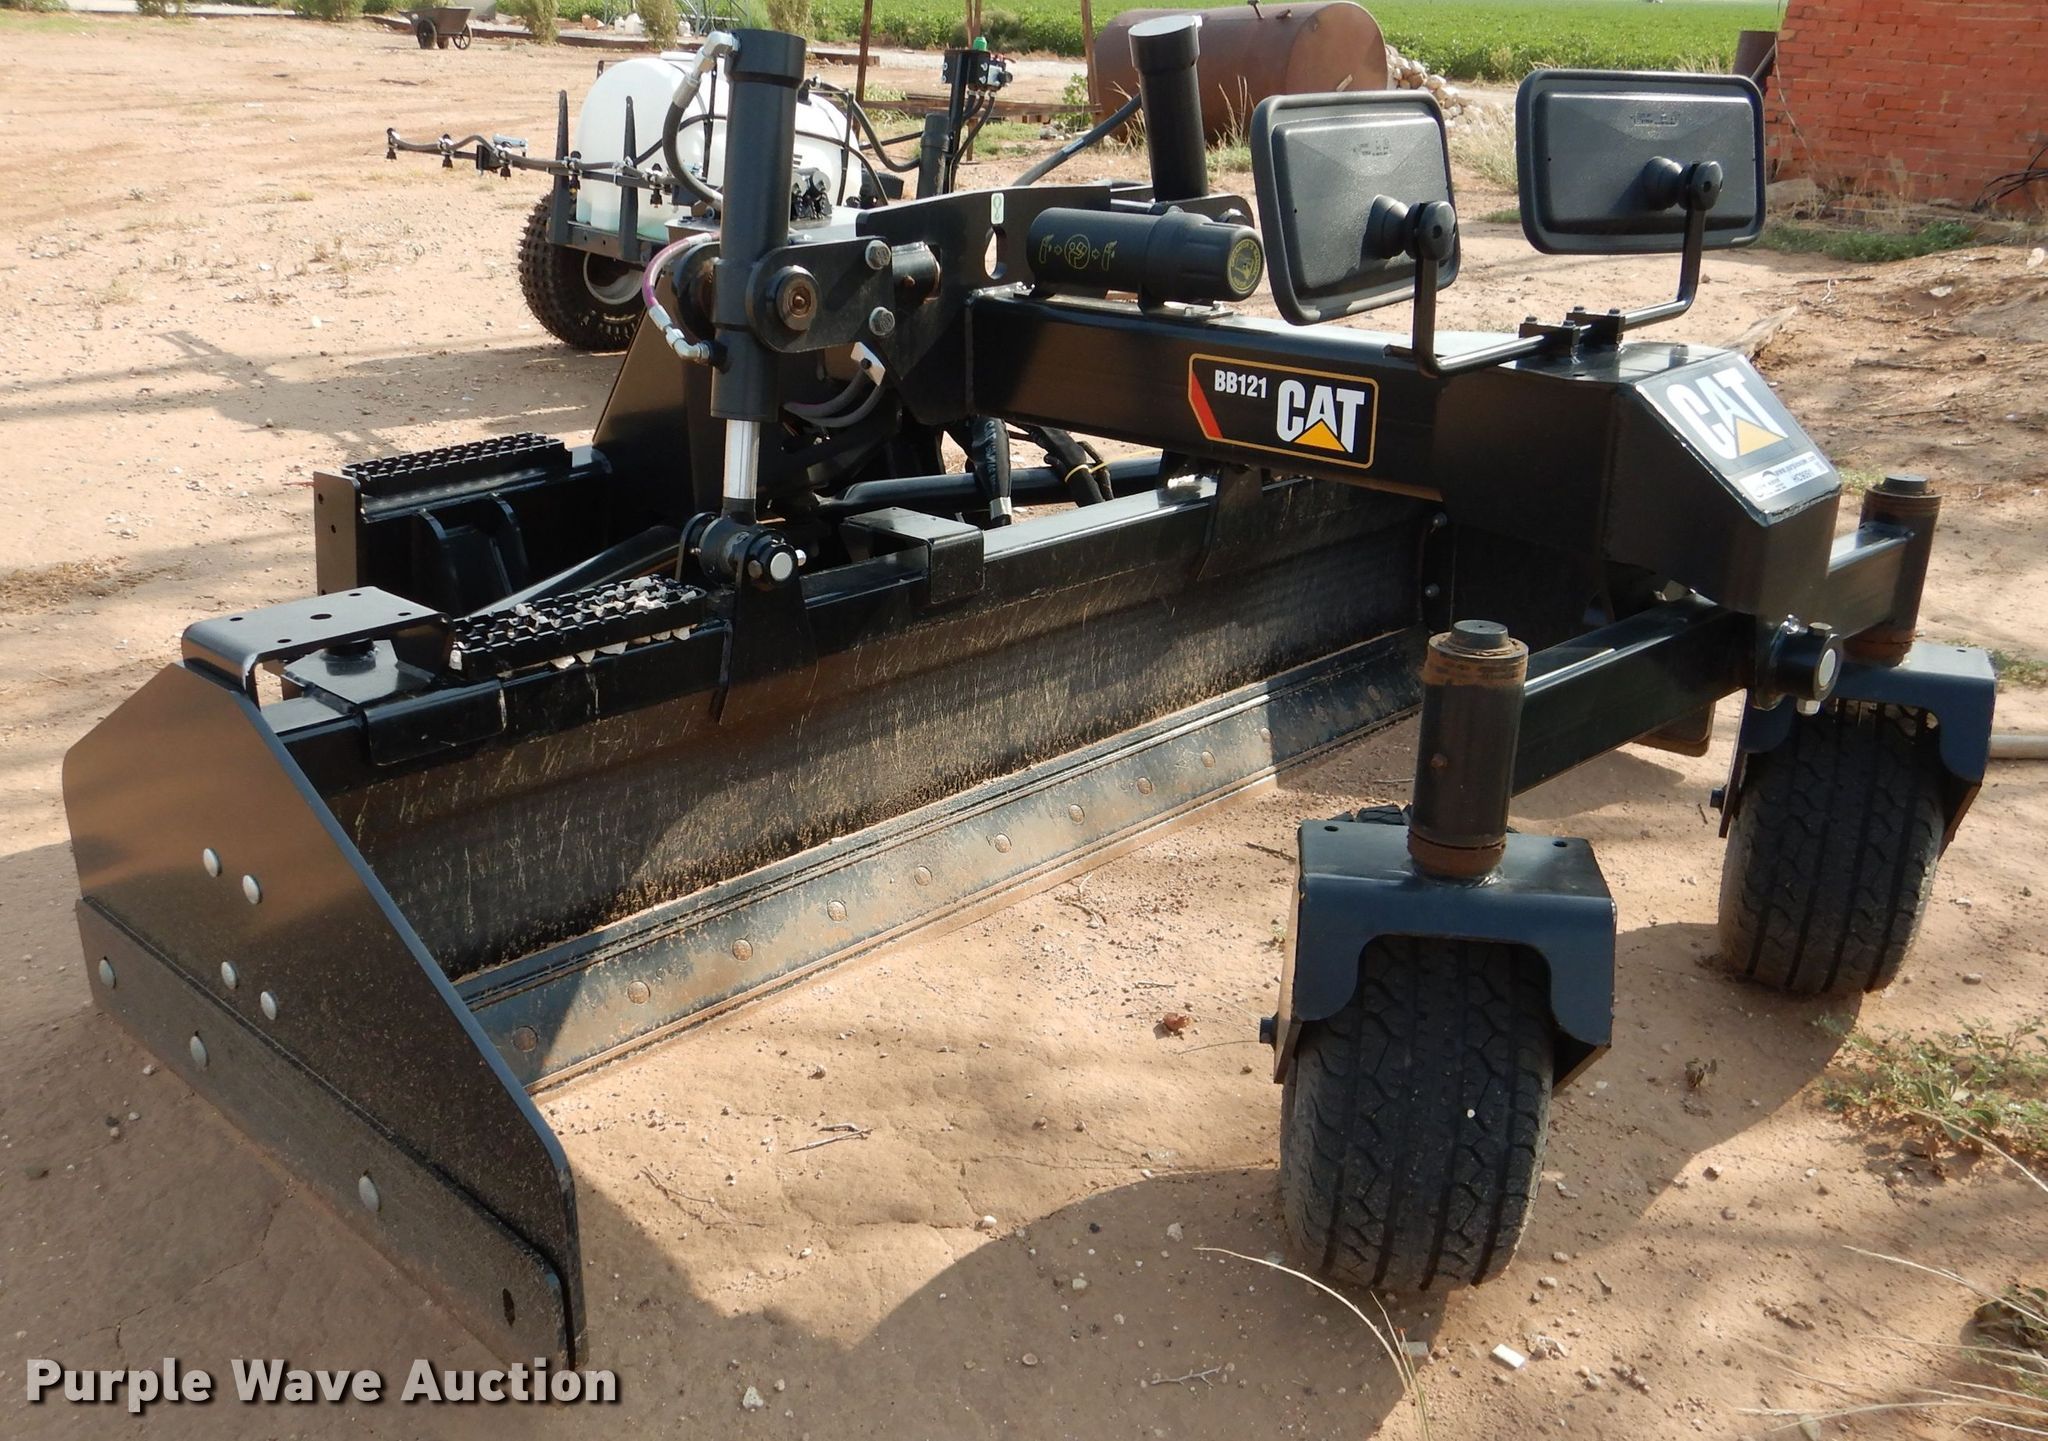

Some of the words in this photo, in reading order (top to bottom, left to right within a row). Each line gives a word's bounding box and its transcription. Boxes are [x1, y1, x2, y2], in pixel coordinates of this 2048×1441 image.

[1214, 370, 1267, 399] BB121
[1276, 379, 1366, 454] CAT
[1666, 367, 1789, 460] CAT
